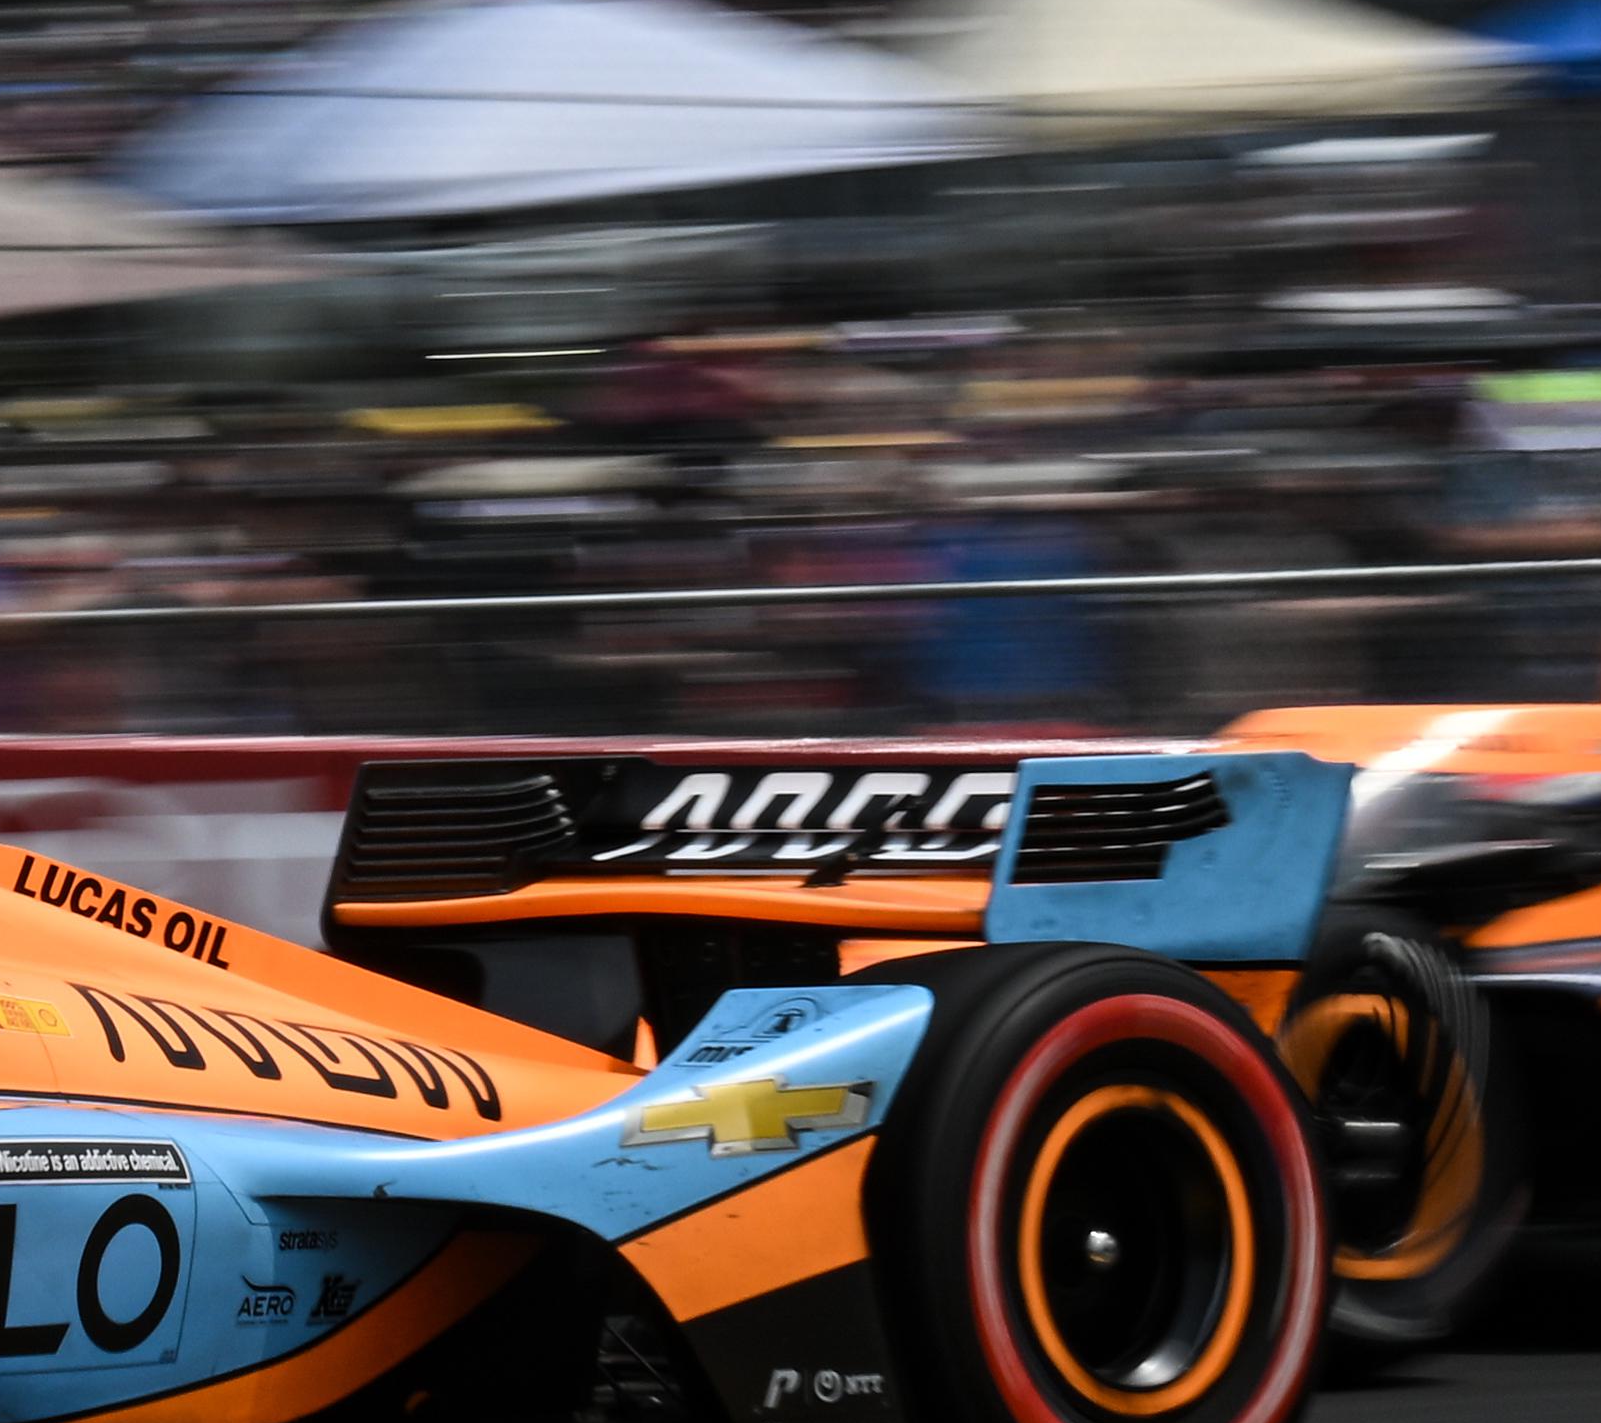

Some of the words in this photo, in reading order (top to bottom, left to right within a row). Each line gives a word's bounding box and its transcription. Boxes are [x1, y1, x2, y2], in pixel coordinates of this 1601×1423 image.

[13, 855, 157, 939] LUCAS
[162, 911, 230, 971] OIL
[50, 1150, 63, 1171] is
[63, 1154, 79, 1171] an
[80, 1149, 129, 1172] addictive
[130, 1149, 180, 1171] chemical.
[237, 1295, 294, 1317] AERO
